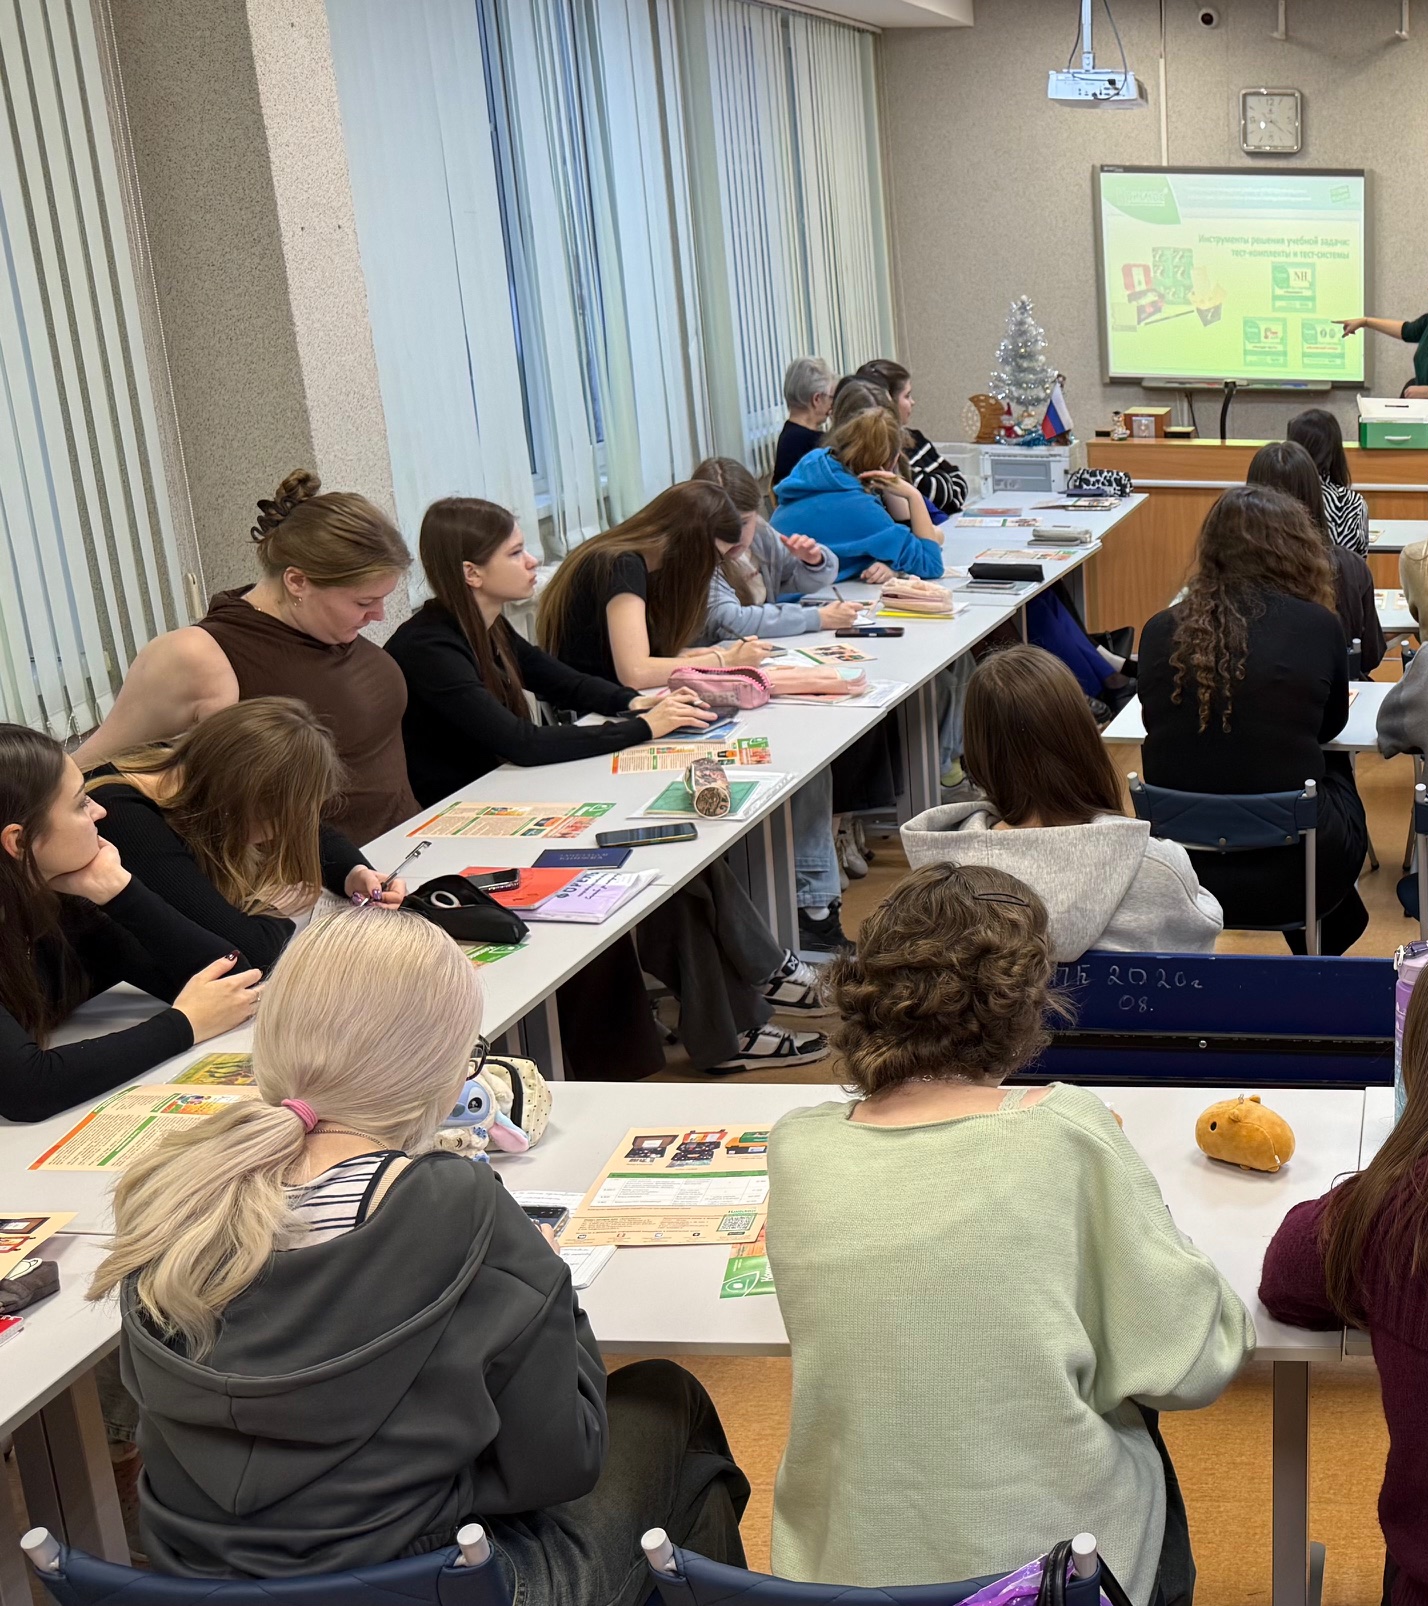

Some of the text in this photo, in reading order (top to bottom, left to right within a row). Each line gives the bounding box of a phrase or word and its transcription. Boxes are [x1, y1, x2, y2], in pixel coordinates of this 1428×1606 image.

[1265, 97, 1275, 106] 12
[1198, 234, 1249, 246] Инструменты
[1250, 235, 1286, 247] решения
[1287, 235, 1319, 247] учебной
